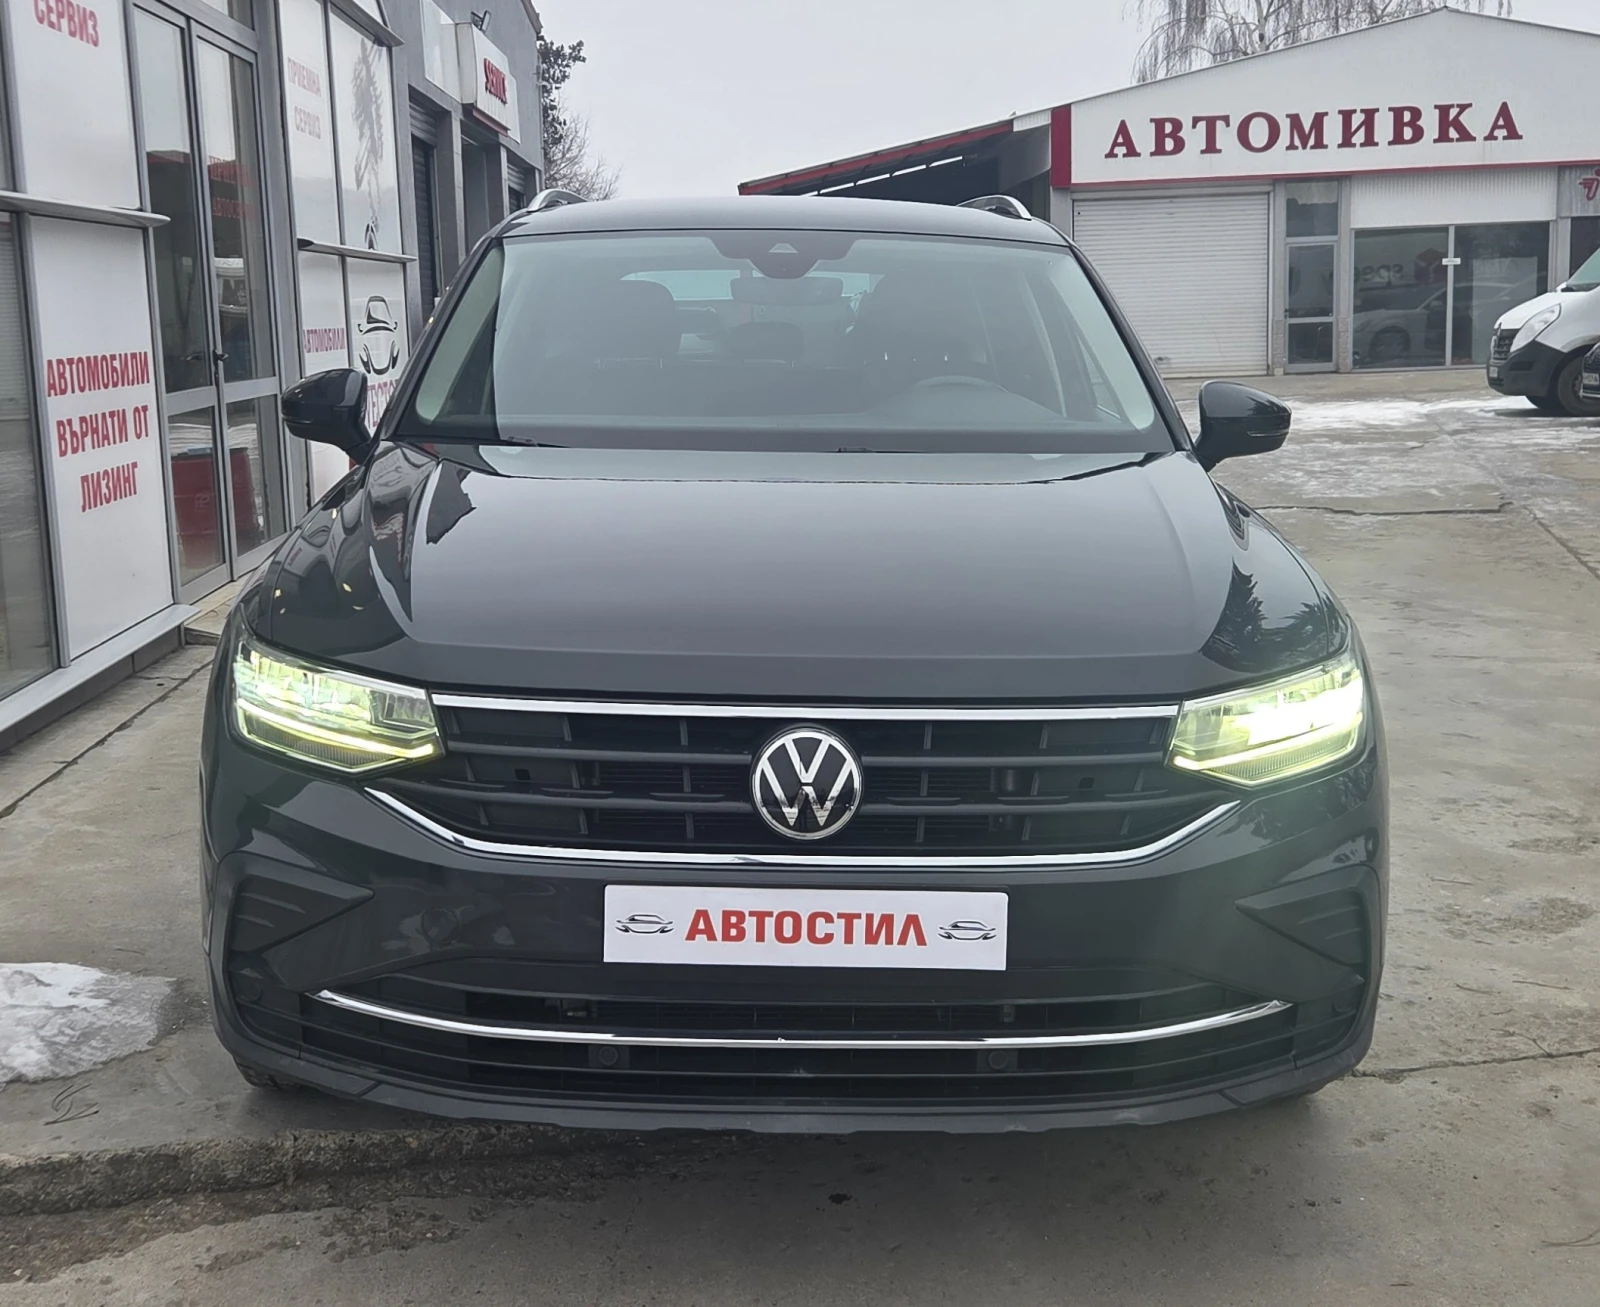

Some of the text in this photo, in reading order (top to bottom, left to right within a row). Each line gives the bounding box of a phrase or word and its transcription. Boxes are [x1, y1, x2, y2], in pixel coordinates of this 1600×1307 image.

[33, 0, 99, 47] СЕРВИЗ
[1104, 101, 1523, 159] АВТОМИВКА
[47, 351, 150, 397] АВТОМОБИЛИ
[56, 405, 149, 457] ВЪРНАТИ ОТ
[80, 461, 138, 513] ЛИЗИНГ
[685, 909, 927, 946] АВТОСТИЛ
